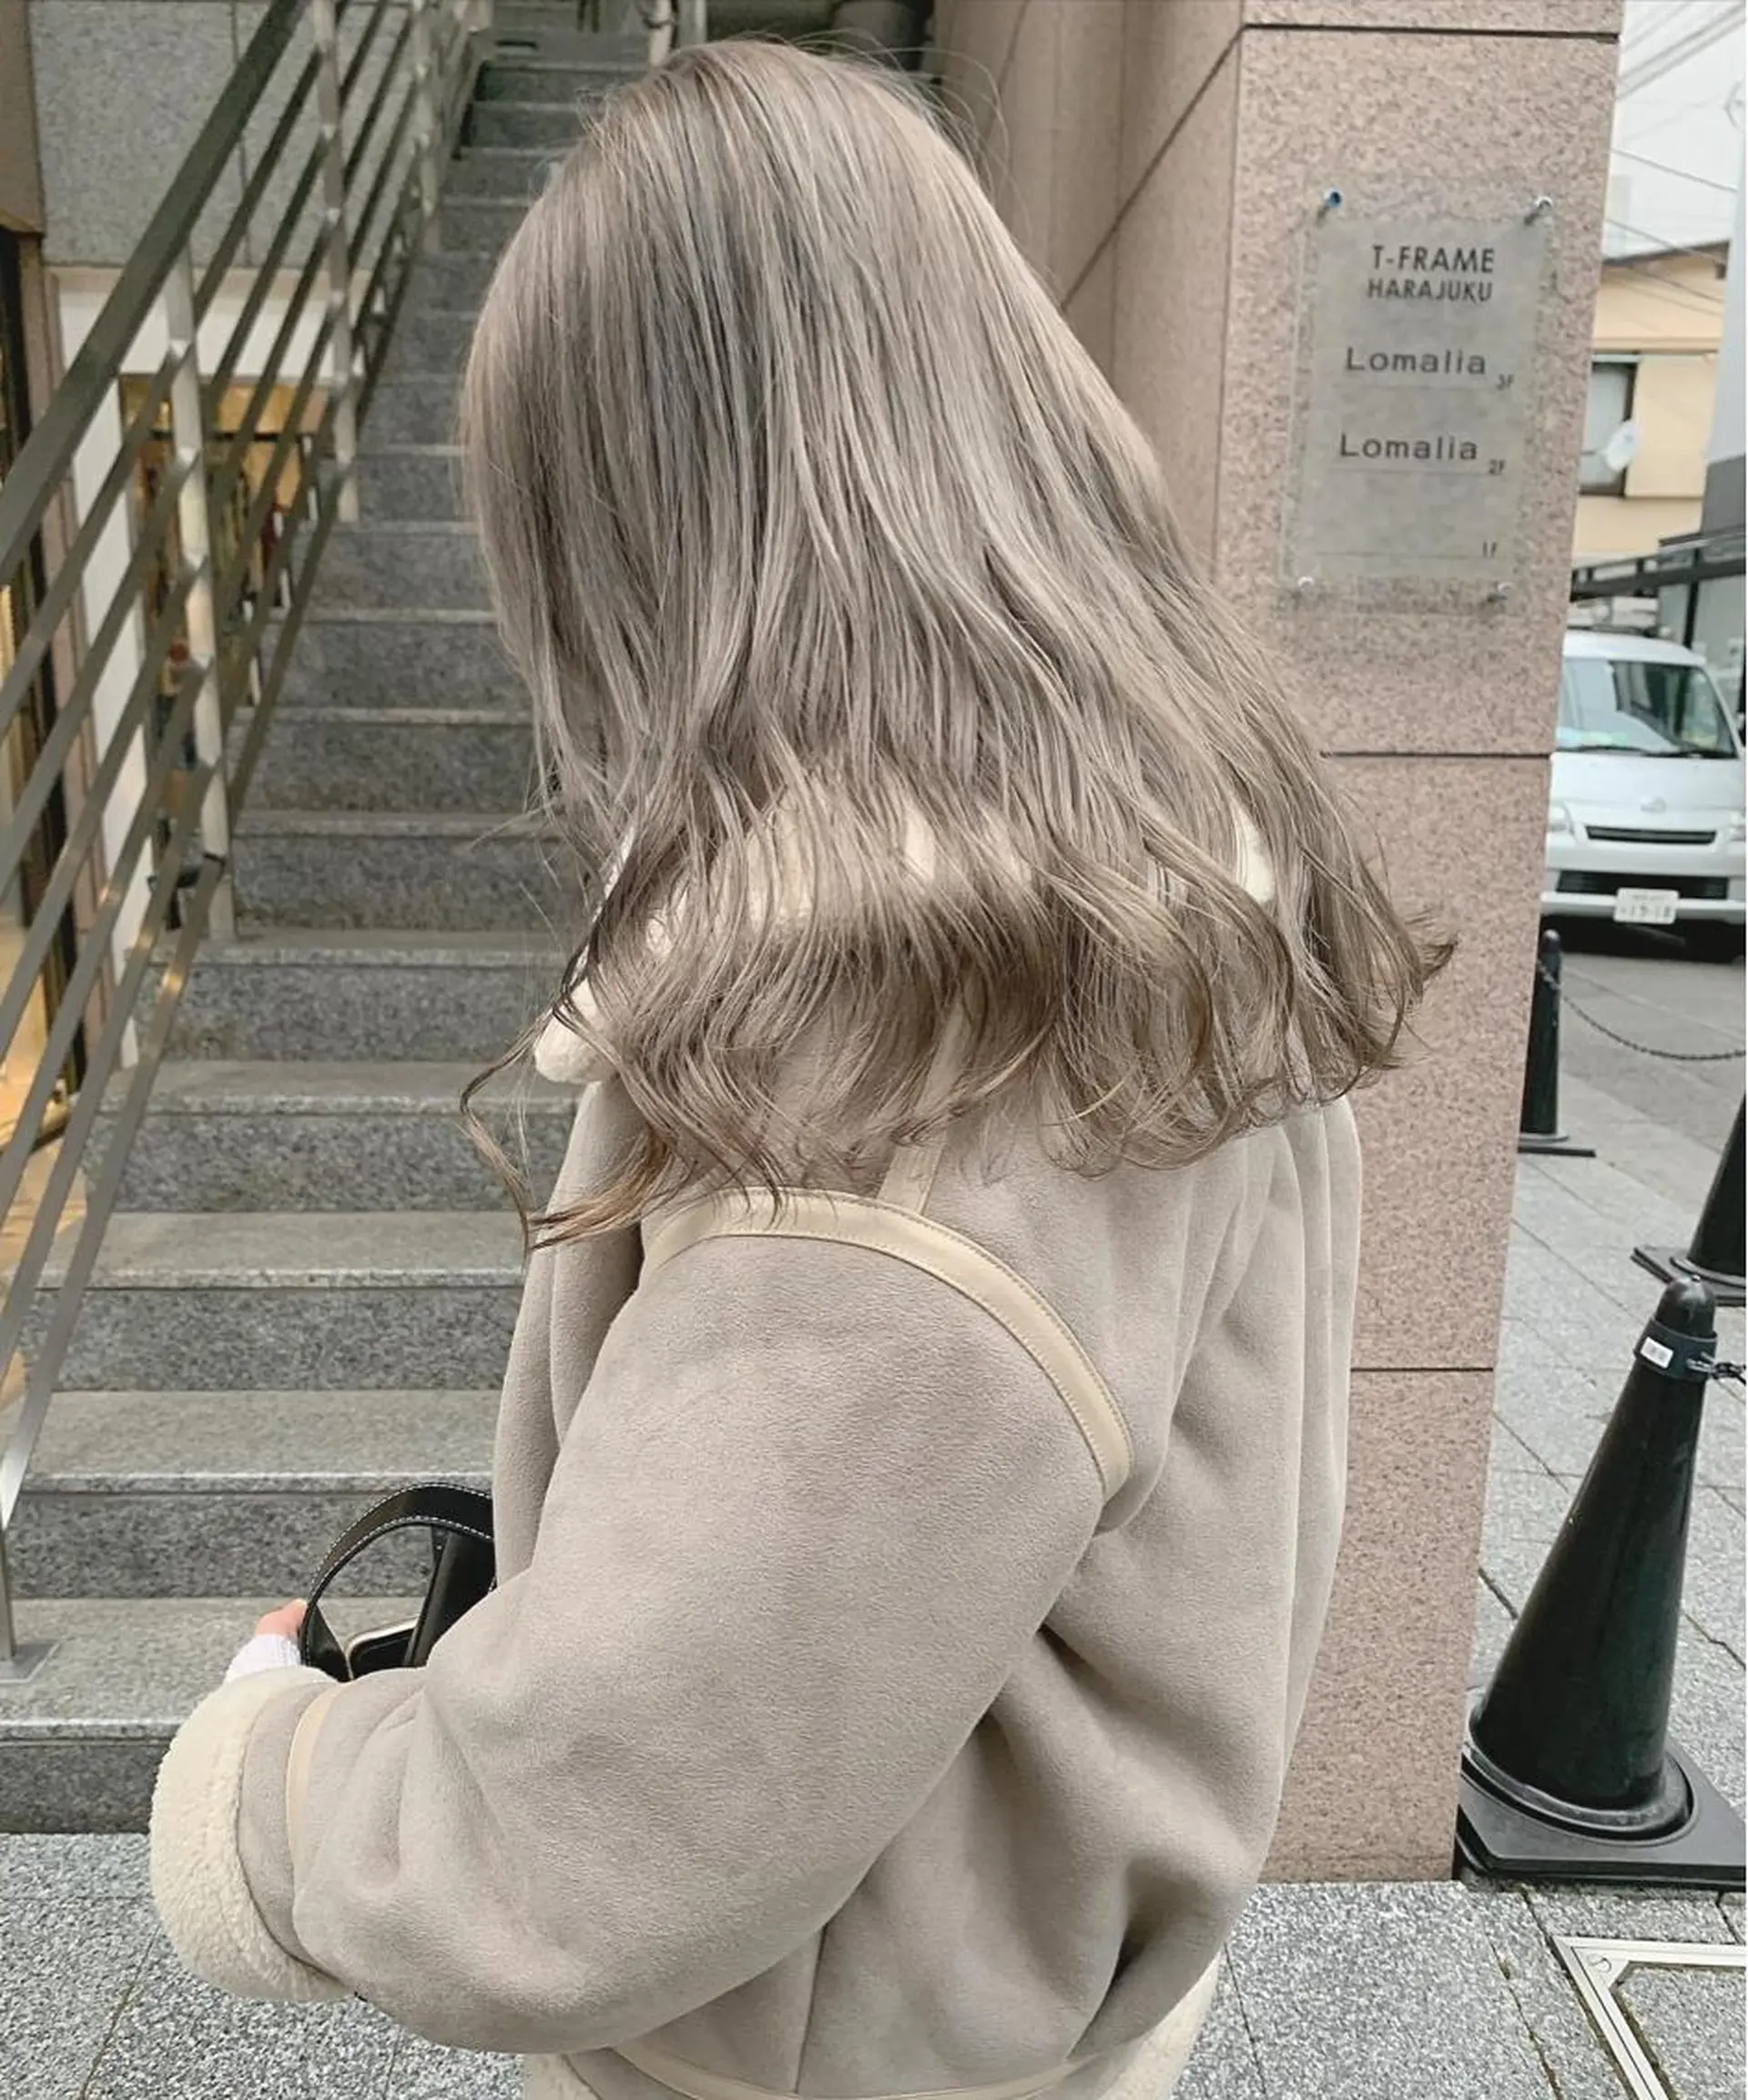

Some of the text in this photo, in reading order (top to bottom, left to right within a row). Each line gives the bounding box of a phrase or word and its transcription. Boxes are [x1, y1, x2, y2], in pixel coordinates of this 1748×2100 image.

[1373, 244, 1495, 273] T-FRAME
[1367, 278, 1493, 303] HARAJUKU
[1345, 347, 1487, 376] Lomalia
[1339, 433, 1506, 474] Lomalia 2F
[1482, 542, 1499, 557] 1F
